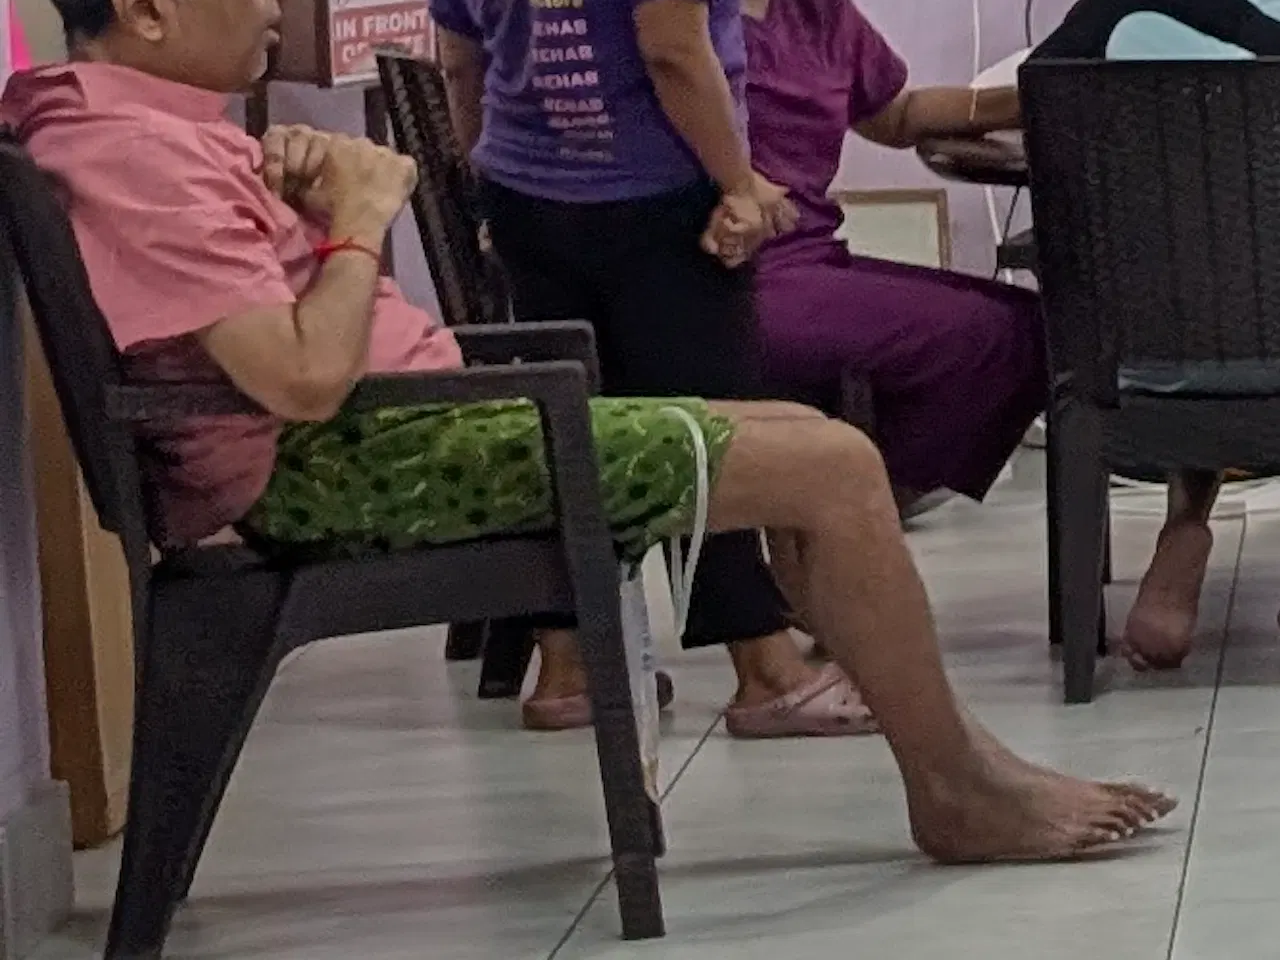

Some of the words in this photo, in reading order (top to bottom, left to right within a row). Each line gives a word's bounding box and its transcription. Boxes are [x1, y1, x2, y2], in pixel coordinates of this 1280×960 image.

[335, 17, 357, 38] IN
[362, 7, 427, 37] FRONT
[532, 19, 588, 37] EHAB
